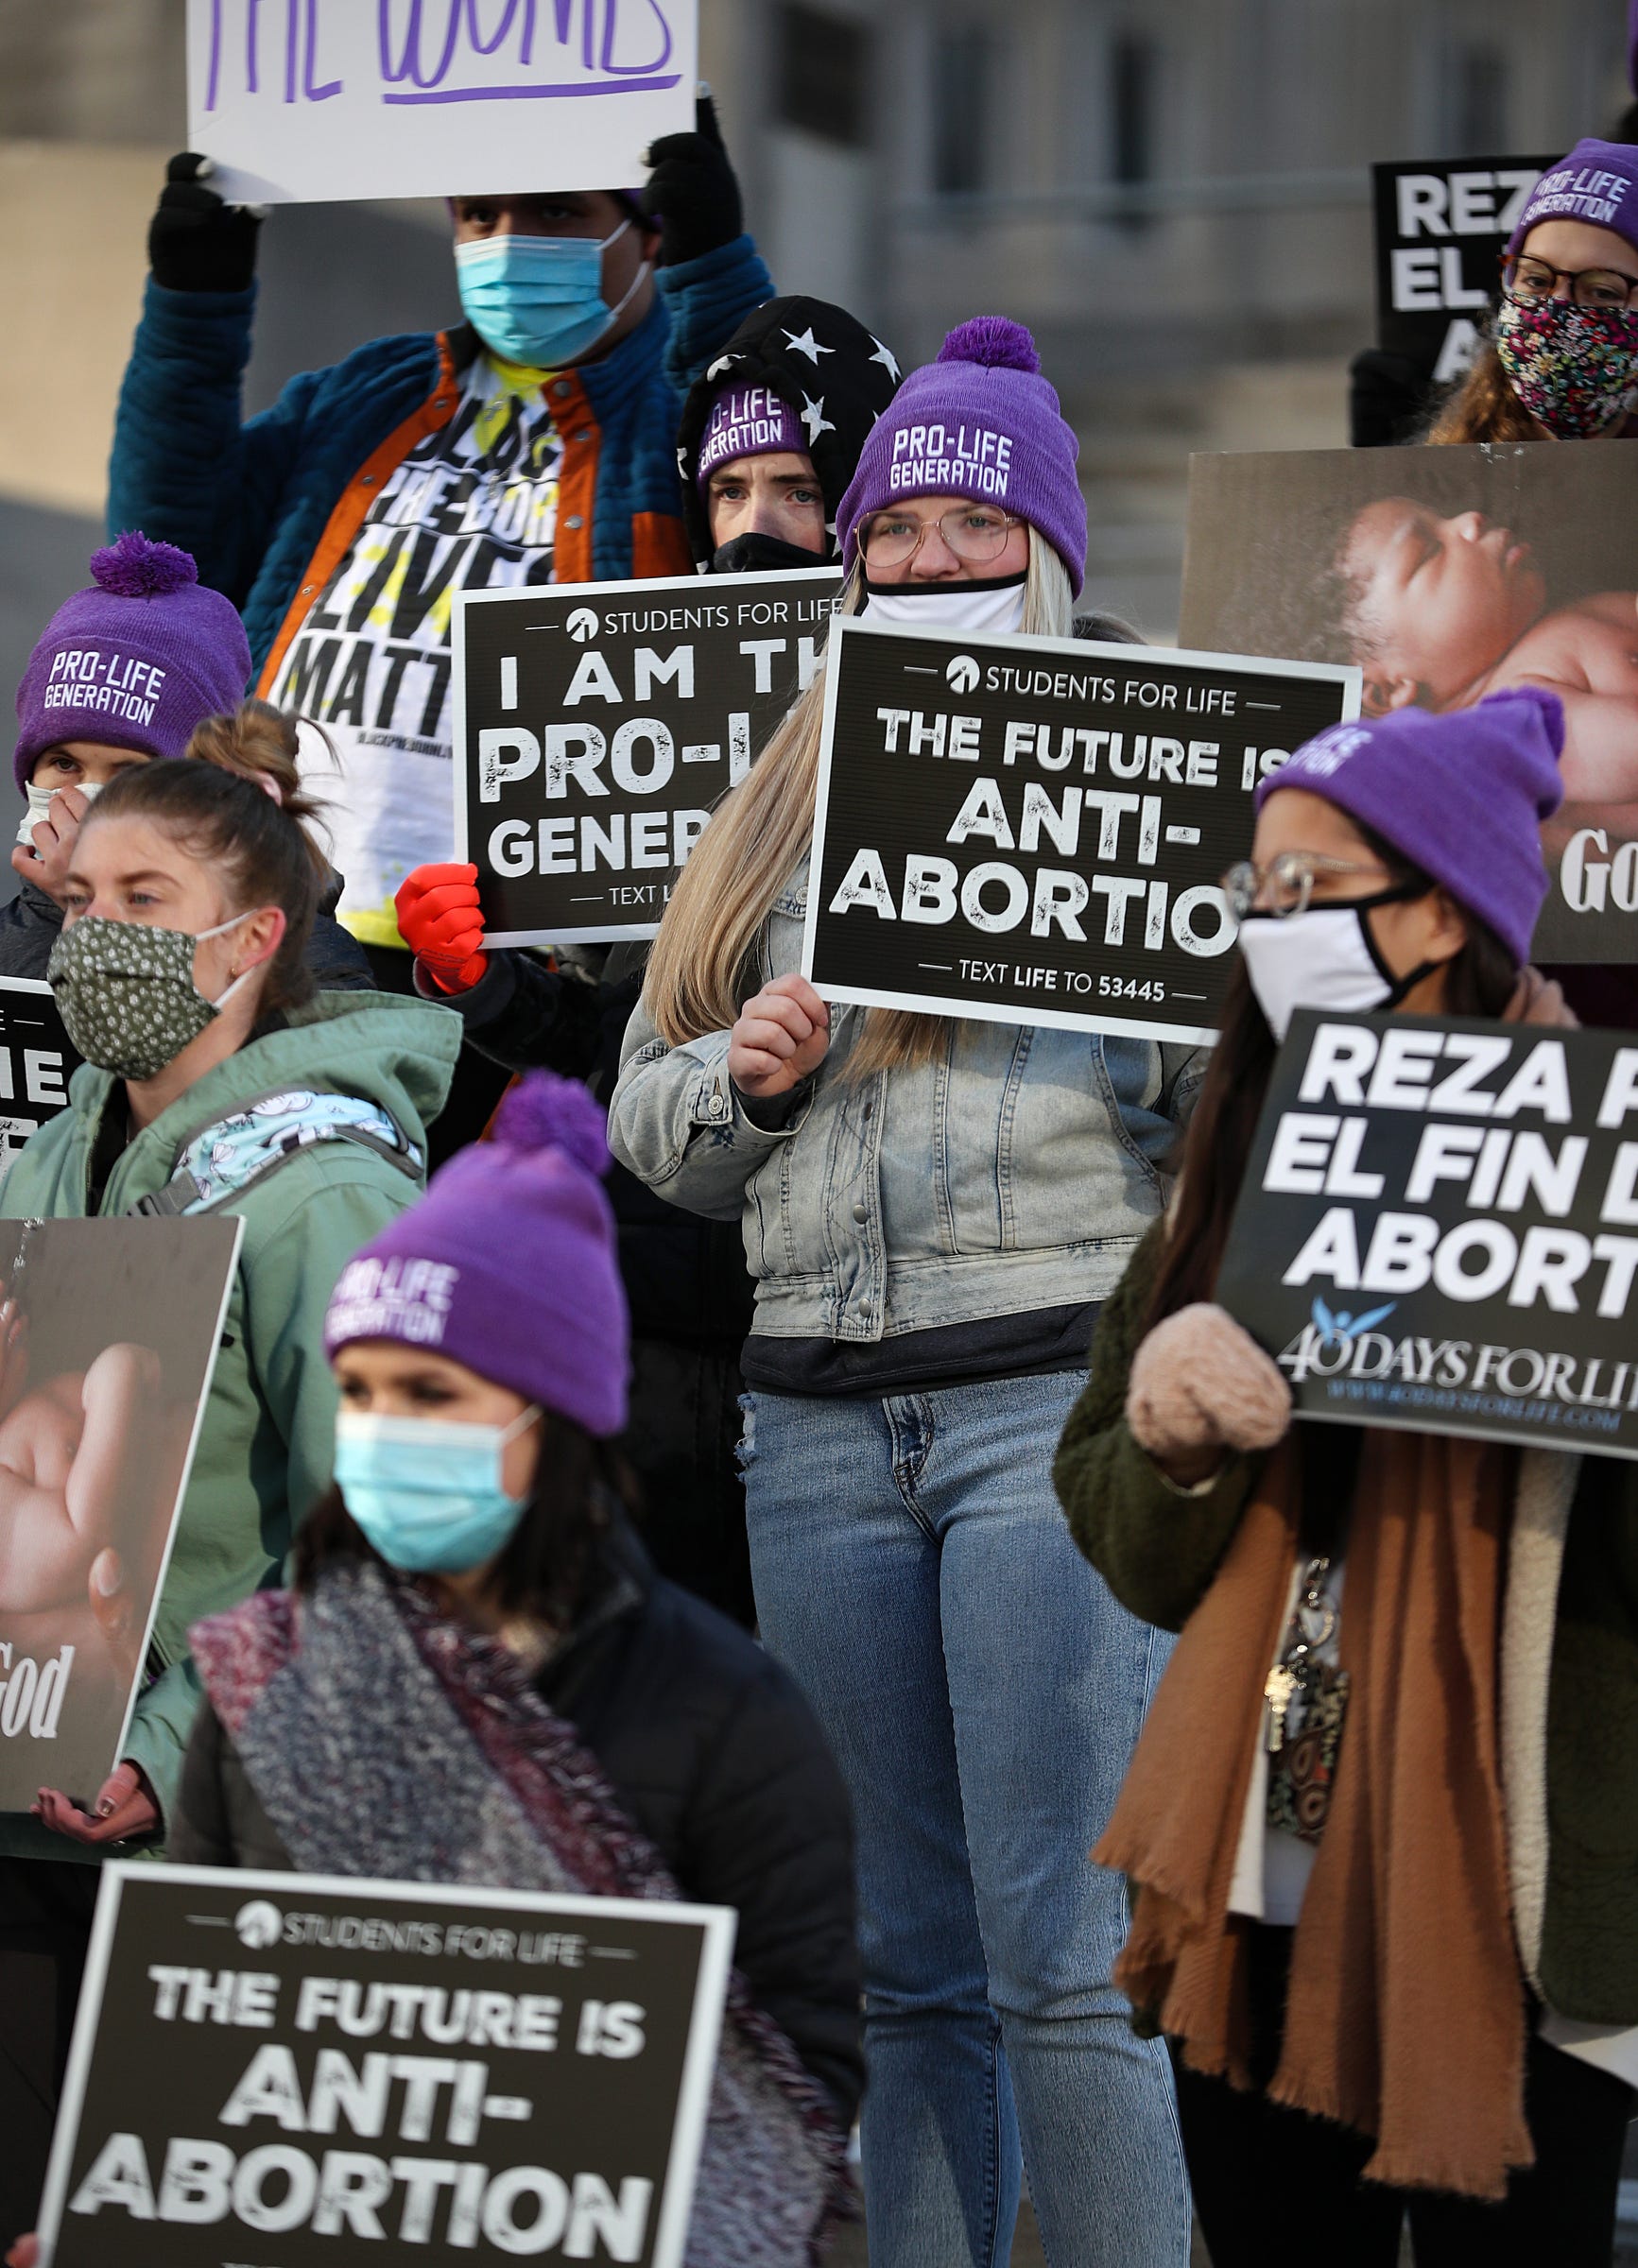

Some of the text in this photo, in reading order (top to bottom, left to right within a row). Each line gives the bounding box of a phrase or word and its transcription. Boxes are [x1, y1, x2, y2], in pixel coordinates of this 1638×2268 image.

[1390, 247, 1489, 312] EL
[698, 418, 782, 477] ENERATION
[889, 458, 1009, 496] GENERATION
[892, 423, 1013, 469] PRO-LIFE
[605, 606, 730, 636] STUDENTS
[737, 601, 788, 625] FOR
[44, 683, 155, 727] GENERATION
[48, 650, 166, 699] PRO-LIFE
[500, 656, 519, 711] I
[562, 644, 696, 707] AM
[986, 665, 1237, 716] STUDENTS FOR LIFE
[876, 707, 982, 761] THE
[1003, 721, 1220, 788] FUTURE
[946, 777, 1201, 867] ANTI-
[609, 885, 658, 905] TEXT
[828, 848, 1239, 958] ABORTIO
[1560, 828, 1638, 913] Go
[958, 958, 1165, 1004] TEXT LIFE TO 53445
[1297, 1022, 1573, 1125] REZA
[1262, 1111, 1386, 1200] EL
[1404, 1123, 1590, 1218] FIN
[1281, 1207, 1638, 1320] ABORT
[284, 1912, 588, 1968] STUDENTS FOR LIFE
[147, 1965, 647, 2060] THE FUTURE IS
[218, 2043, 533, 2147] ANTI-
[67, 2132, 655, 2264] ABORTION
